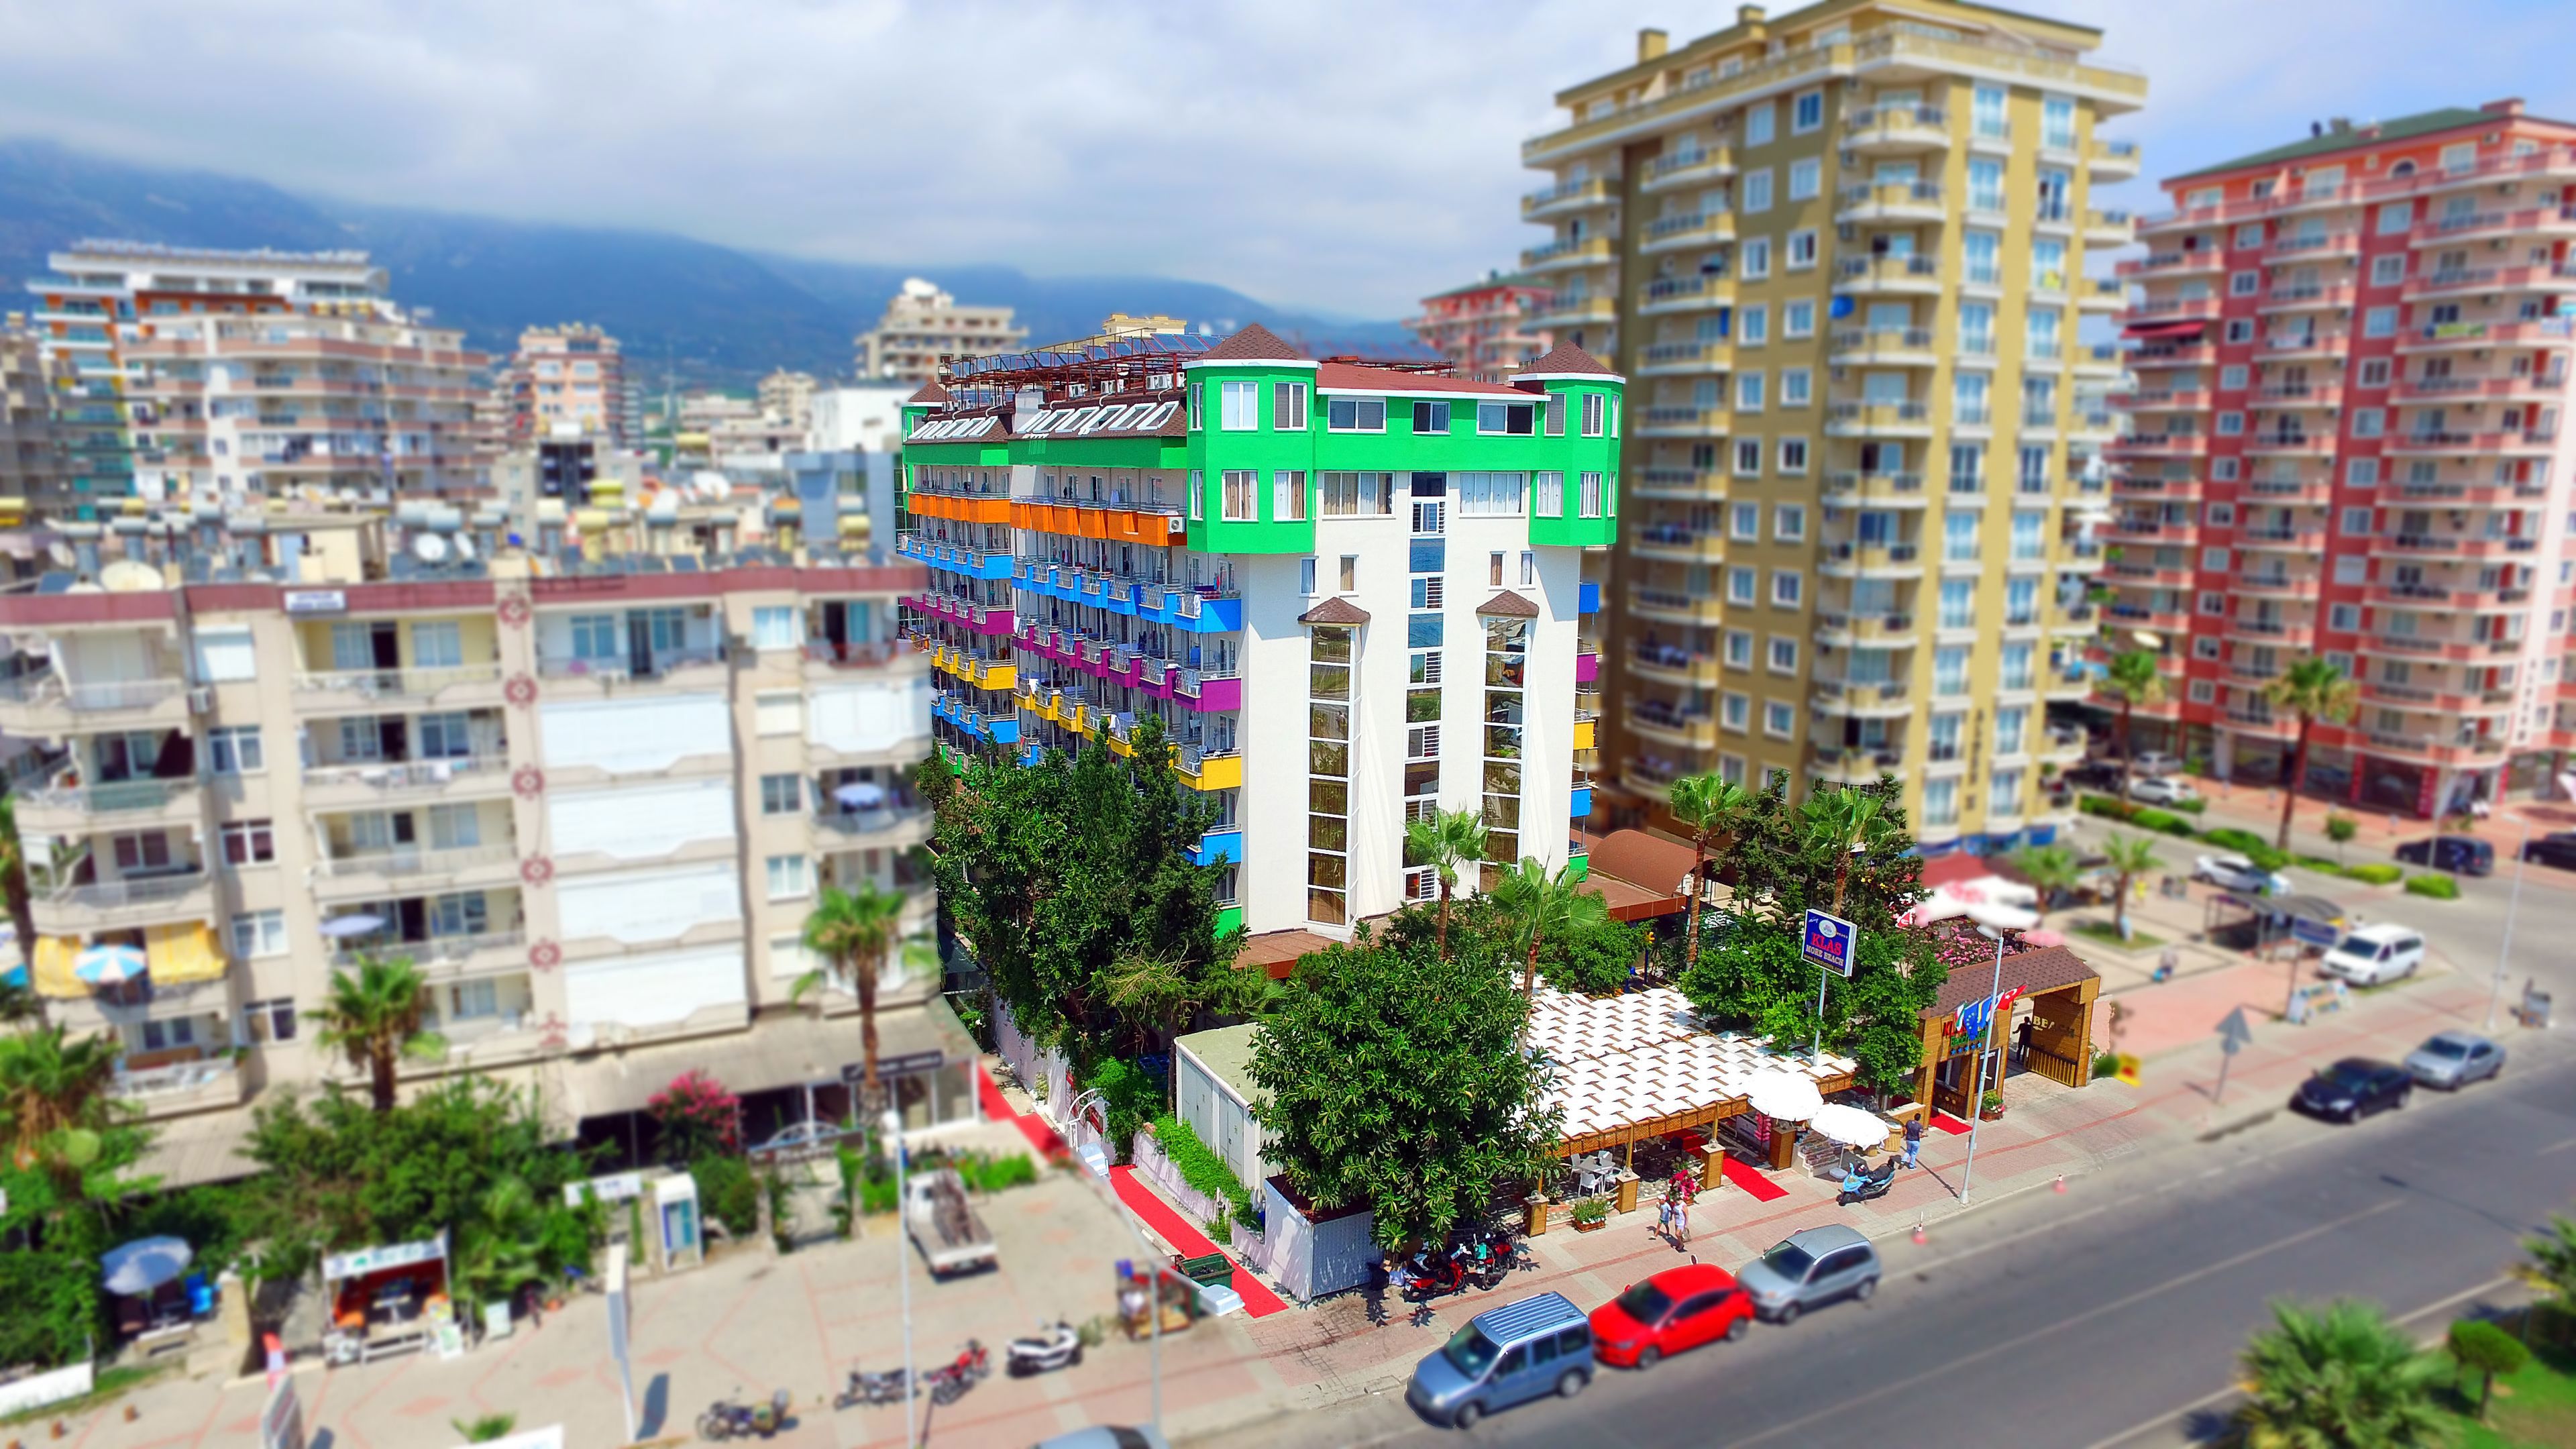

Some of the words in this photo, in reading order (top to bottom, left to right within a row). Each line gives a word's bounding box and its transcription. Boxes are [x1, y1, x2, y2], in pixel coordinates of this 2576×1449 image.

[1812, 932, 1842, 955] KLAS
[1806, 945, 1823, 957] MORE
[1824, 952, 1844, 966] BEACH
